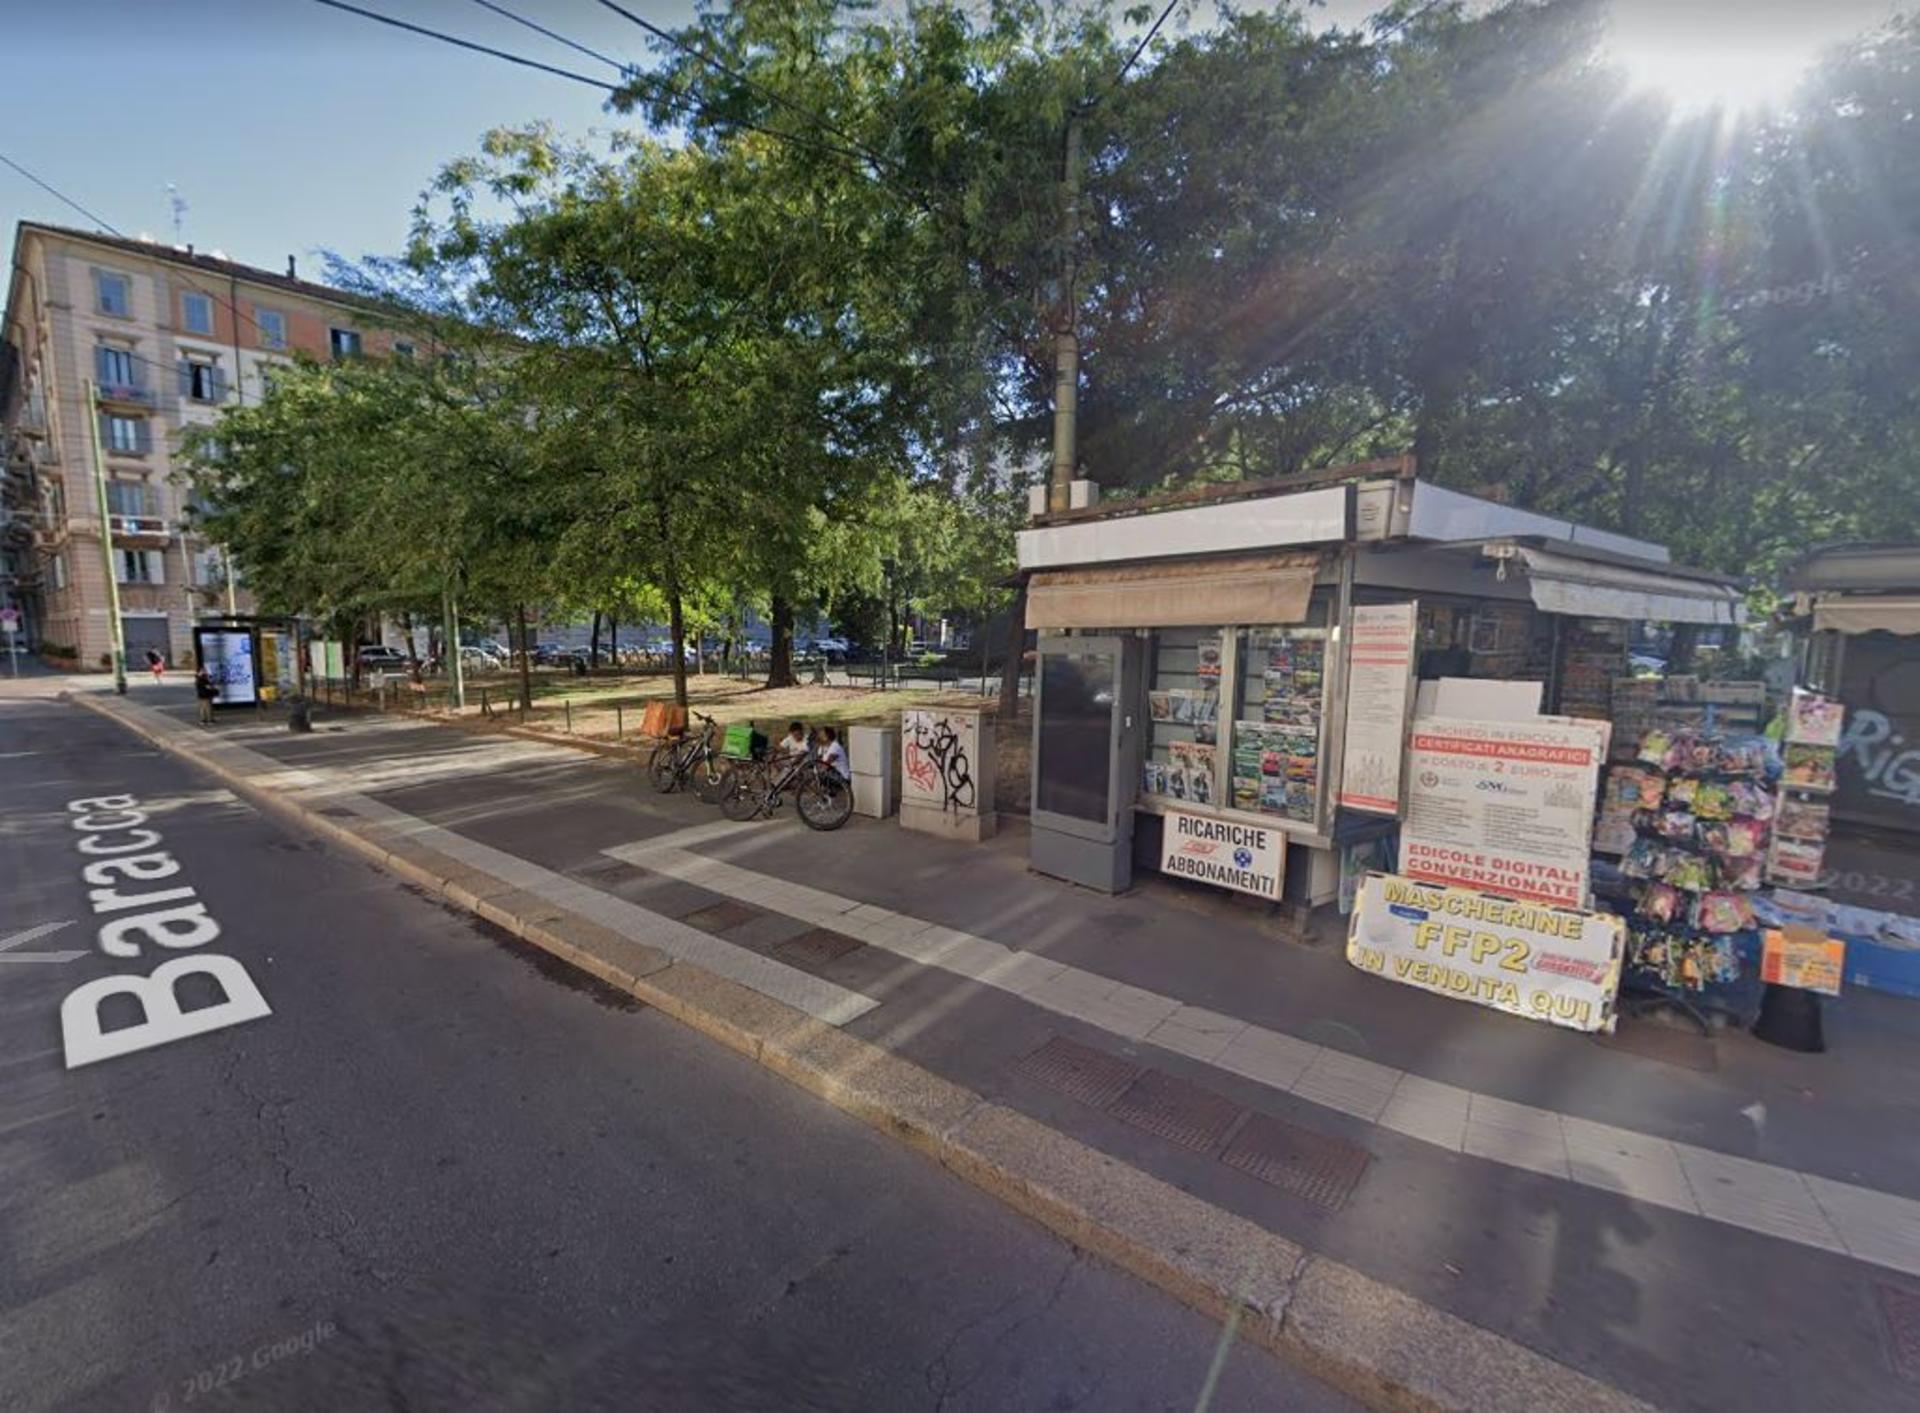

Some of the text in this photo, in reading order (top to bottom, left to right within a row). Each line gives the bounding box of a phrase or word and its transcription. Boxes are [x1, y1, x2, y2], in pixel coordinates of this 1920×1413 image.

[1418, 738, 1587, 763] CERTIFICATI ANAGRAFICI
[1178, 816, 1267, 850] RICARICHE
[1167, 854, 1276, 895] ABBONAMENTI
[1408, 843, 1580, 882] EDICOLE DIGITALI
[1408, 858, 1579, 898] CONVENZIONATE
[1384, 881, 1584, 940] MASCHERINE
[1414, 920, 1531, 973] FFP2
[1358, 948, 1386, 972] IN
[1392, 955, 1520, 1007] VENDITA
[1531, 989, 1593, 1023] QUI
